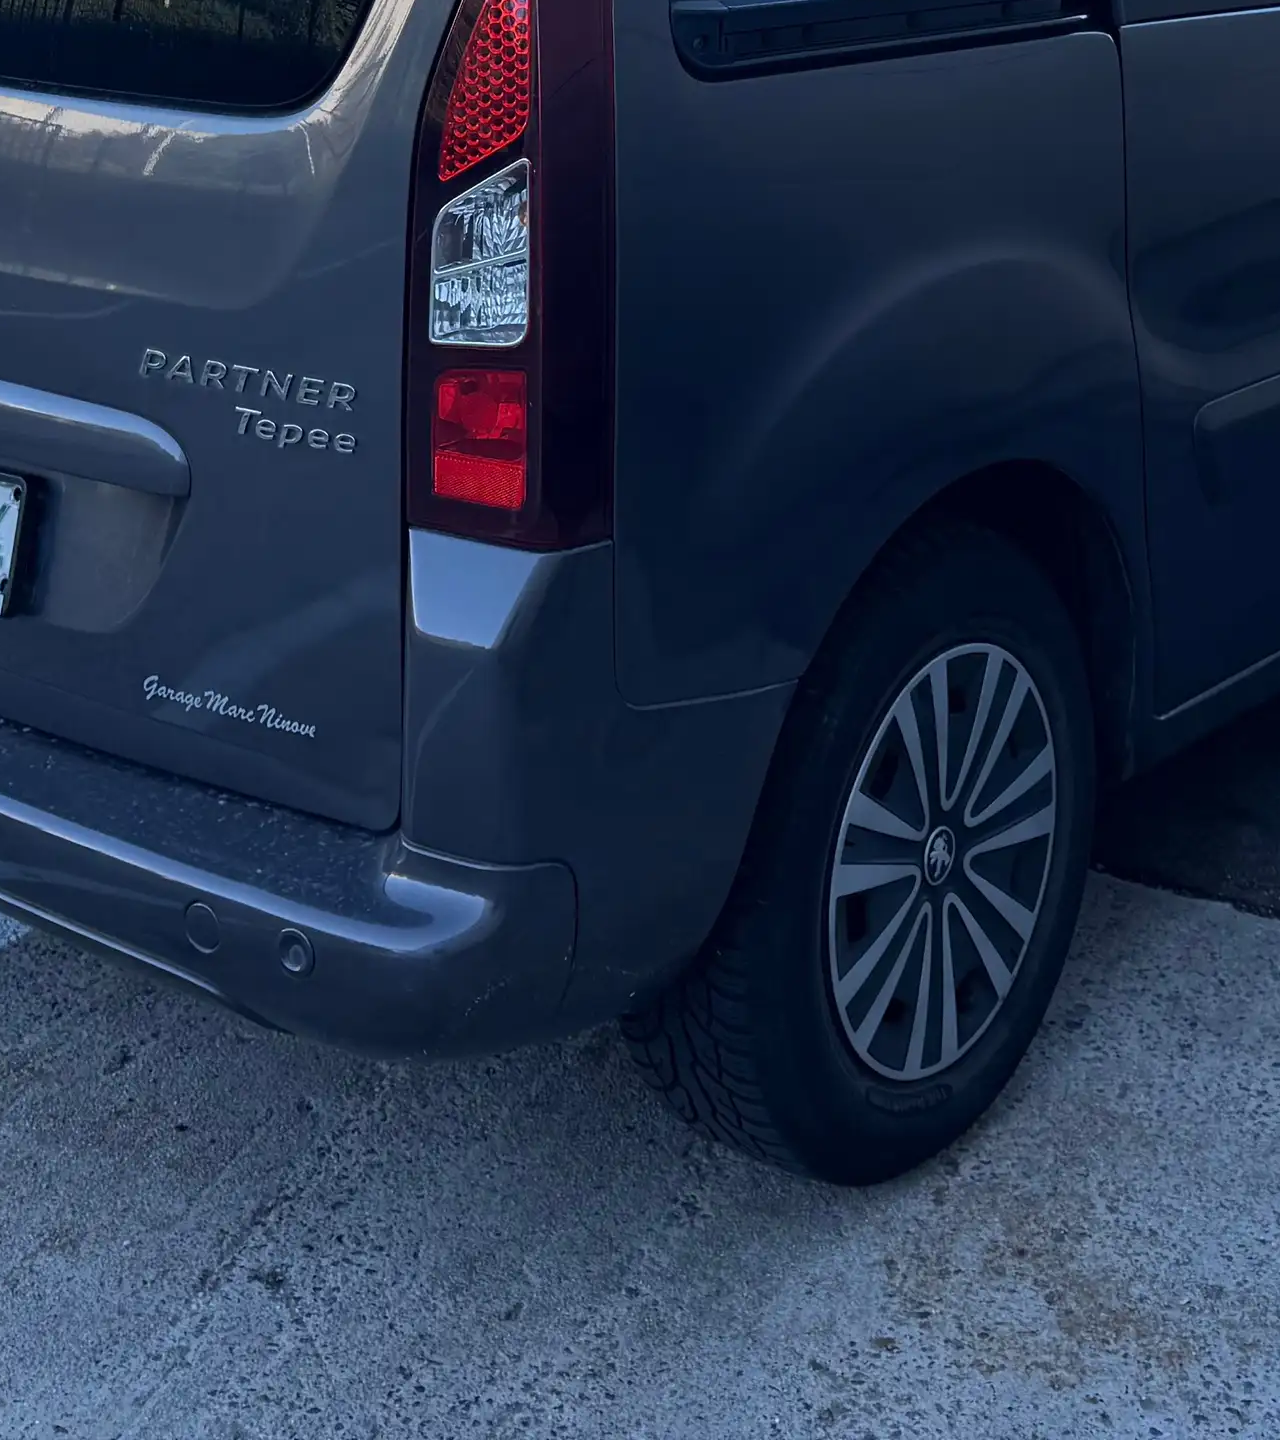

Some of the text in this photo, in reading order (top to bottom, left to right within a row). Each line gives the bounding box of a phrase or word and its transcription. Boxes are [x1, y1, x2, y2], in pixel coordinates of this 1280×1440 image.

[138, 347, 357, 411] PARTNER
[234, 406, 356, 454] Tepee
[143, 675, 203, 712] Garage
[204, 690, 256, 723] Marc
